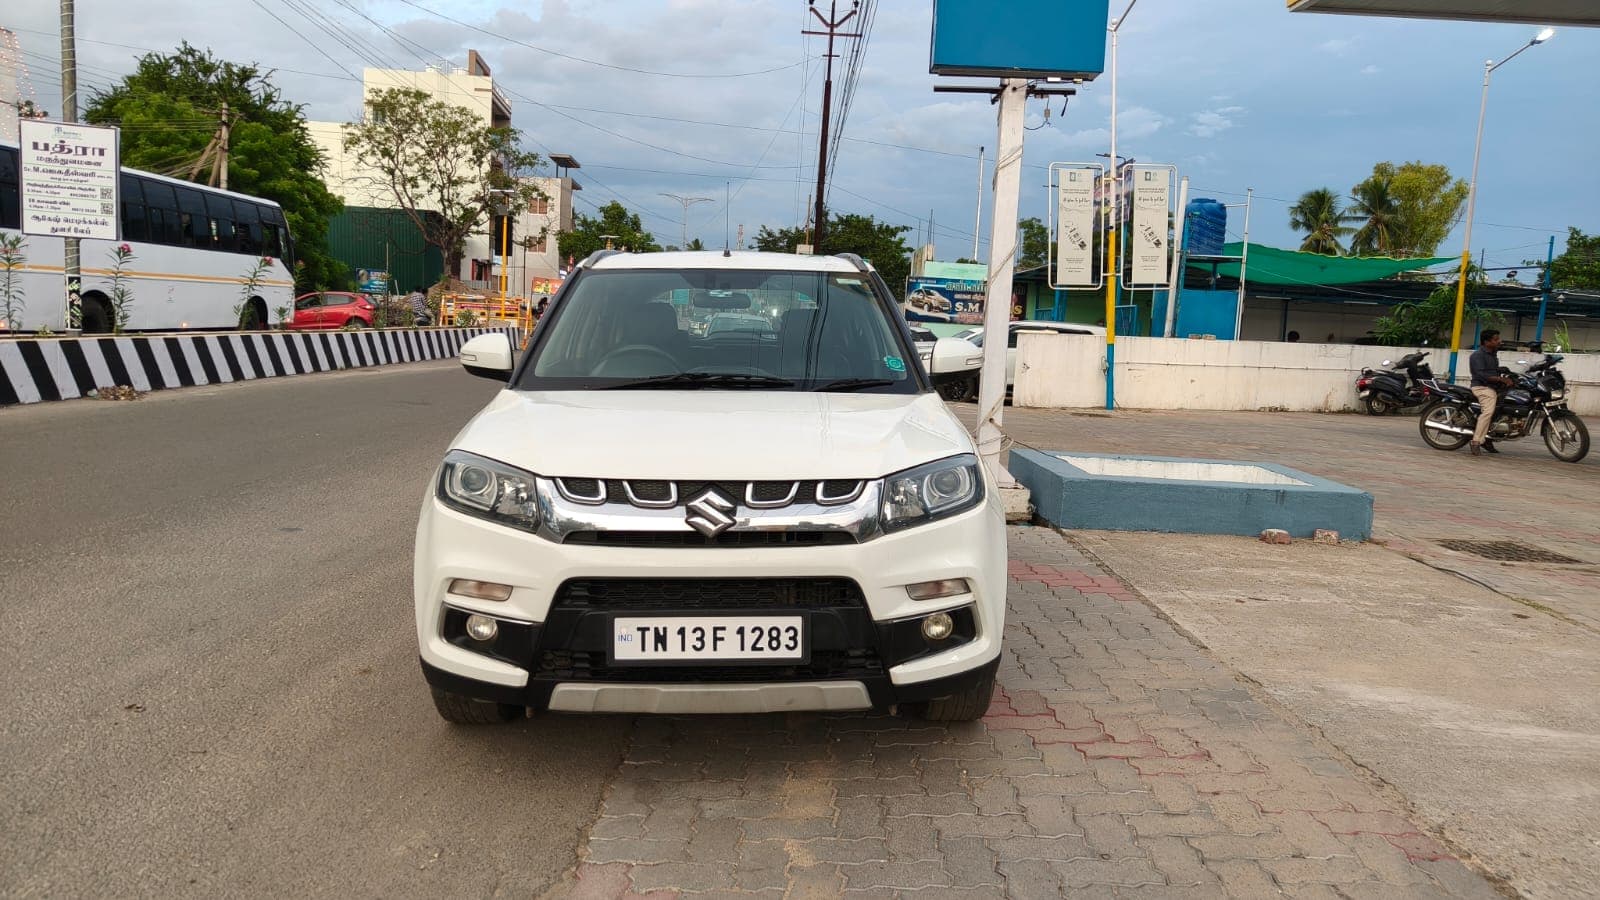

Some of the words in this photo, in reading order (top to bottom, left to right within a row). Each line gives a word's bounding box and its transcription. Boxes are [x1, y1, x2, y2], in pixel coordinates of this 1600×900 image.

[637, 627, 667, 652] TN
[677, 627, 706, 652] 13
[712, 626, 726, 652] F
[736, 626, 798, 652] 1283
